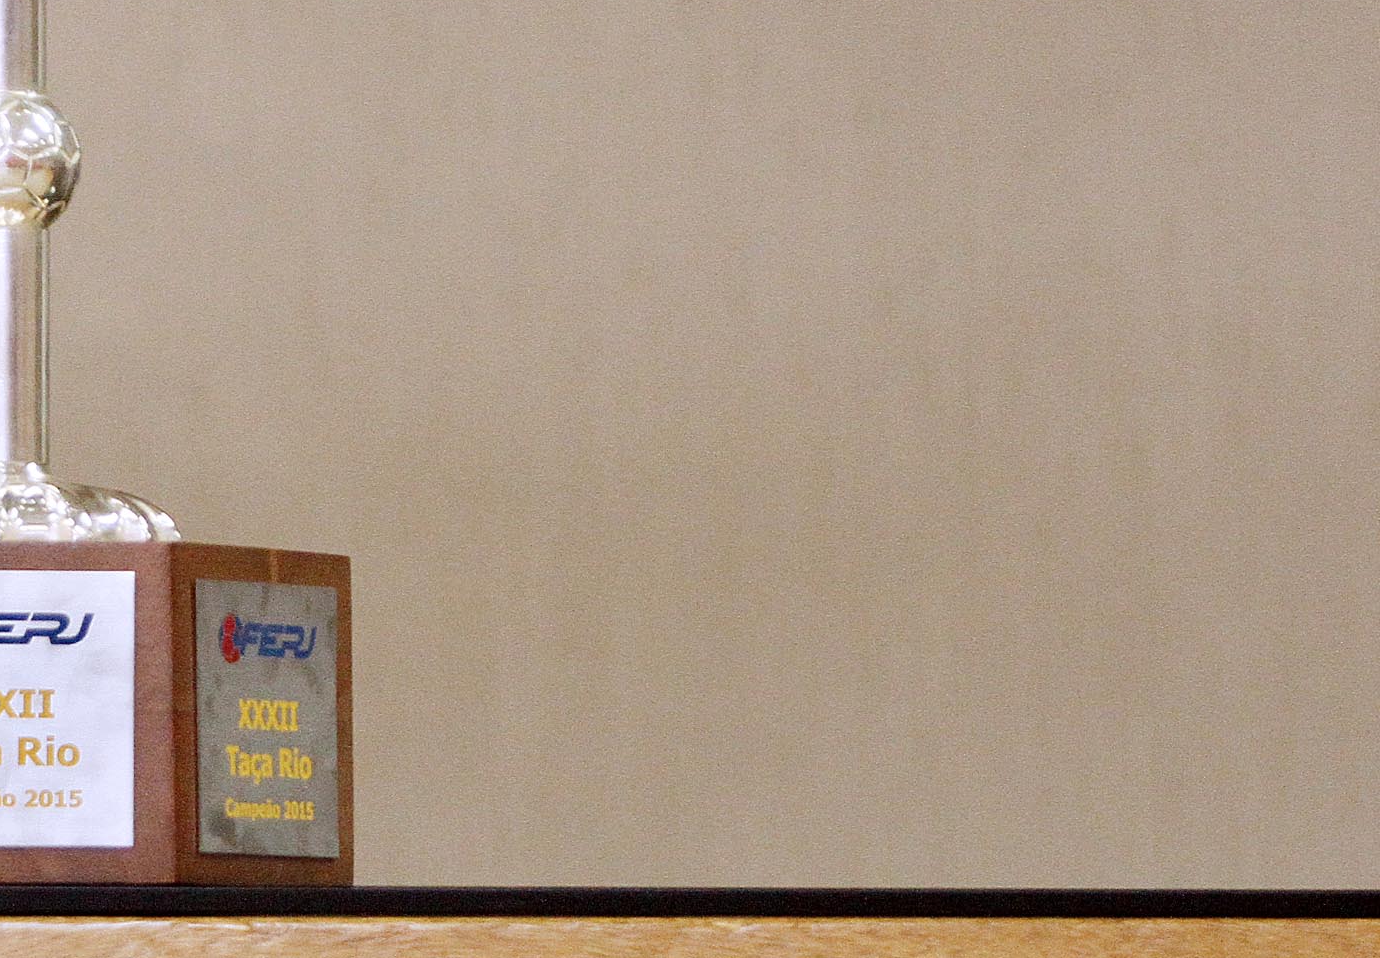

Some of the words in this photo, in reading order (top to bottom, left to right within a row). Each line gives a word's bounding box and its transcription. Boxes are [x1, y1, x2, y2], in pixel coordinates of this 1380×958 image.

[239, 621, 317, 659] FERJ
[238, 698, 300, 732] XXXII
[17, 735, 81, 767] Rio
[225, 744, 275, 785] Taça
[279, 747, 314, 780] Rio
[24, 789, 84, 808] 2015
[224, 797, 282, 821] Campeão
[283, 799, 315, 821] 2015
